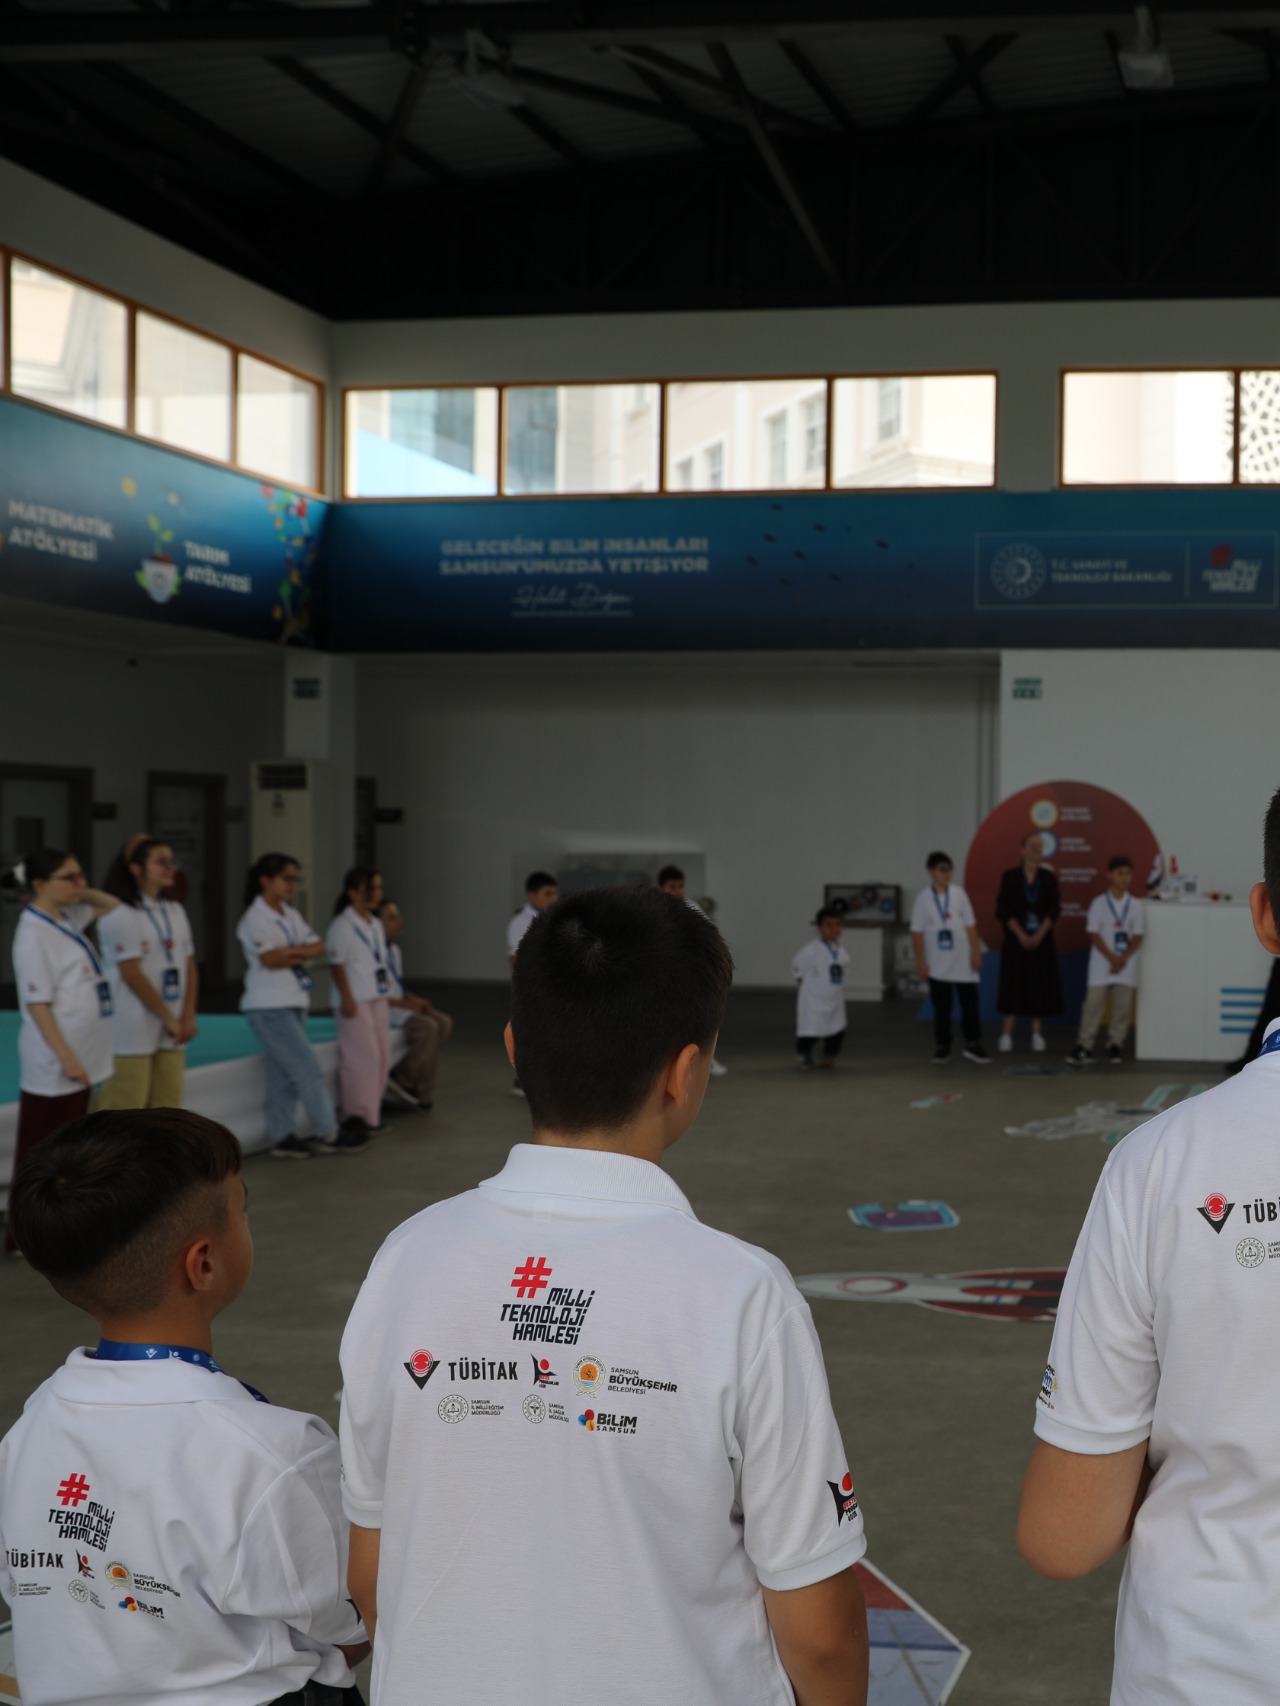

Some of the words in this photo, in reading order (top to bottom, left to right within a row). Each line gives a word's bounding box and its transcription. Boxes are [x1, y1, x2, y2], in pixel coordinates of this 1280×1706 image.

[8, 526, 98, 561] ATÖLYESİ
[500, 1304, 587, 1326] TEKNOLOJİ
[513, 1323, 581, 1345] HAMLESİ
[448, 1357, 518, 1381] TÜBİTAK
[610, 1367, 639, 1376] SAMSUN
[607, 1385, 646, 1395] BELEDİYESİ
[608, 1375, 678, 1393] BÜYÜKŞEHİR
[596, 1413, 637, 1428] BİLİM
[596, 1426, 636, 1435] SAMSUN
[48, 1509, 111, 1538] TEKNOLOJİ
[58, 1525, 108, 1552] HAMLESİ
[5, 1549, 64, 1568] TÜBİTAK
